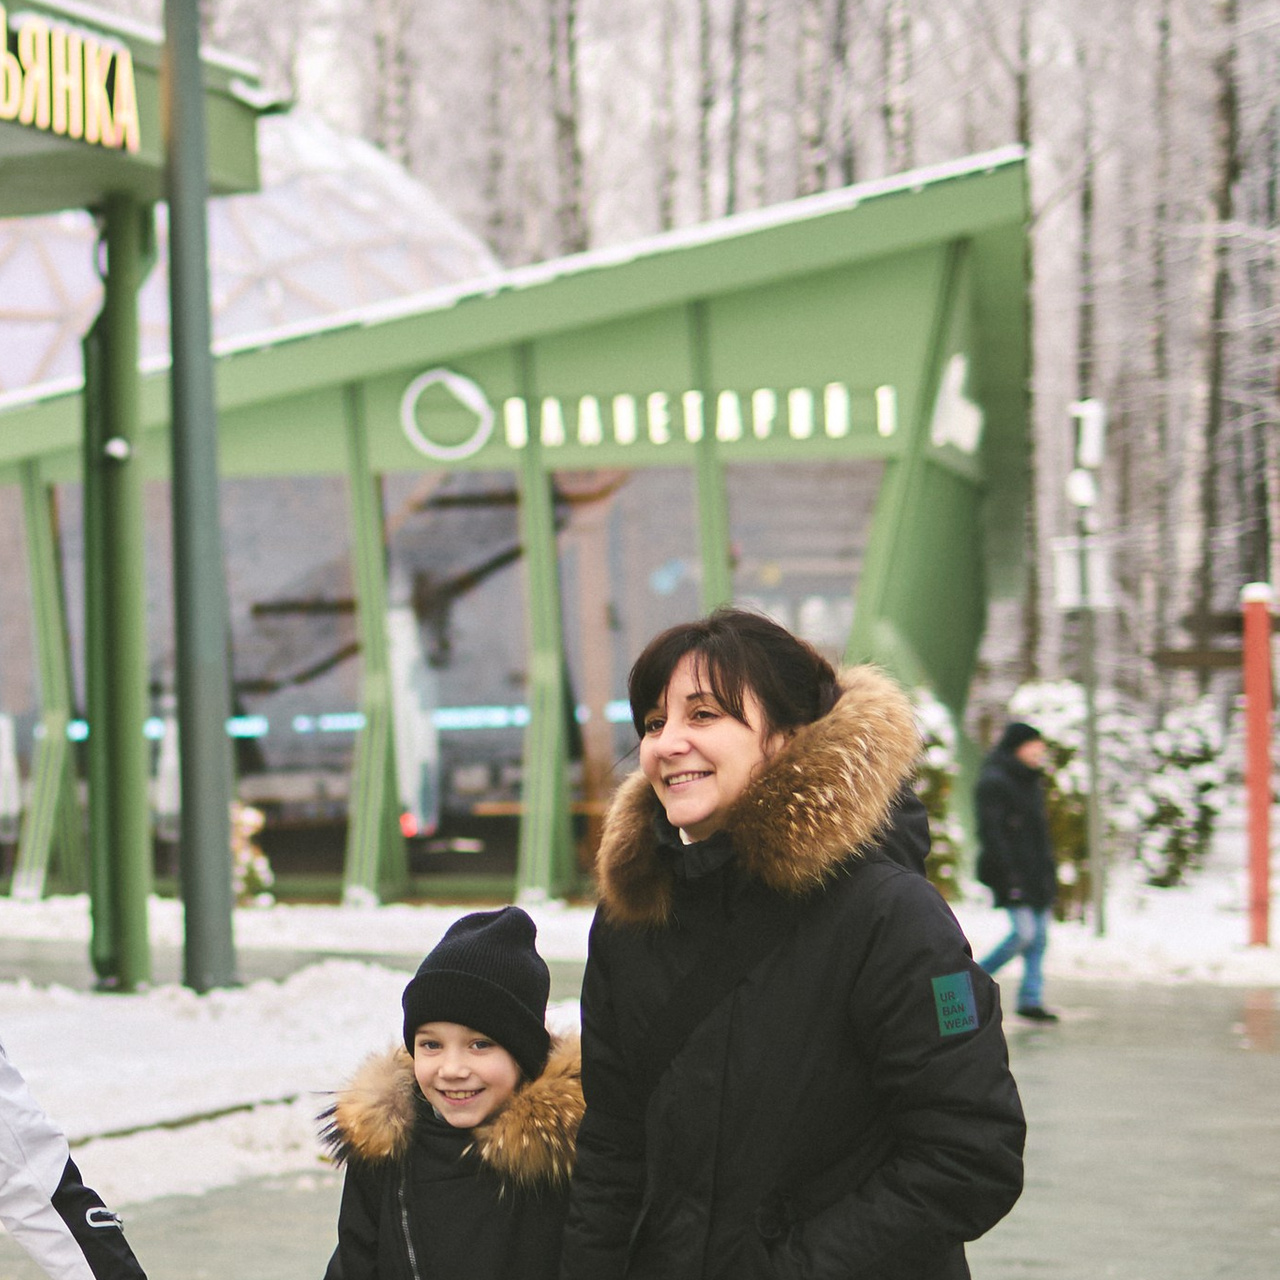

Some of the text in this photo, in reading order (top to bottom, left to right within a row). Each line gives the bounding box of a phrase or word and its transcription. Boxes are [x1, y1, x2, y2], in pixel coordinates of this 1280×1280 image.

[940, 991, 956, 1002] UR
[943, 1003, 965, 1016] BAN
[944, 1015, 975, 1030] WEAR
